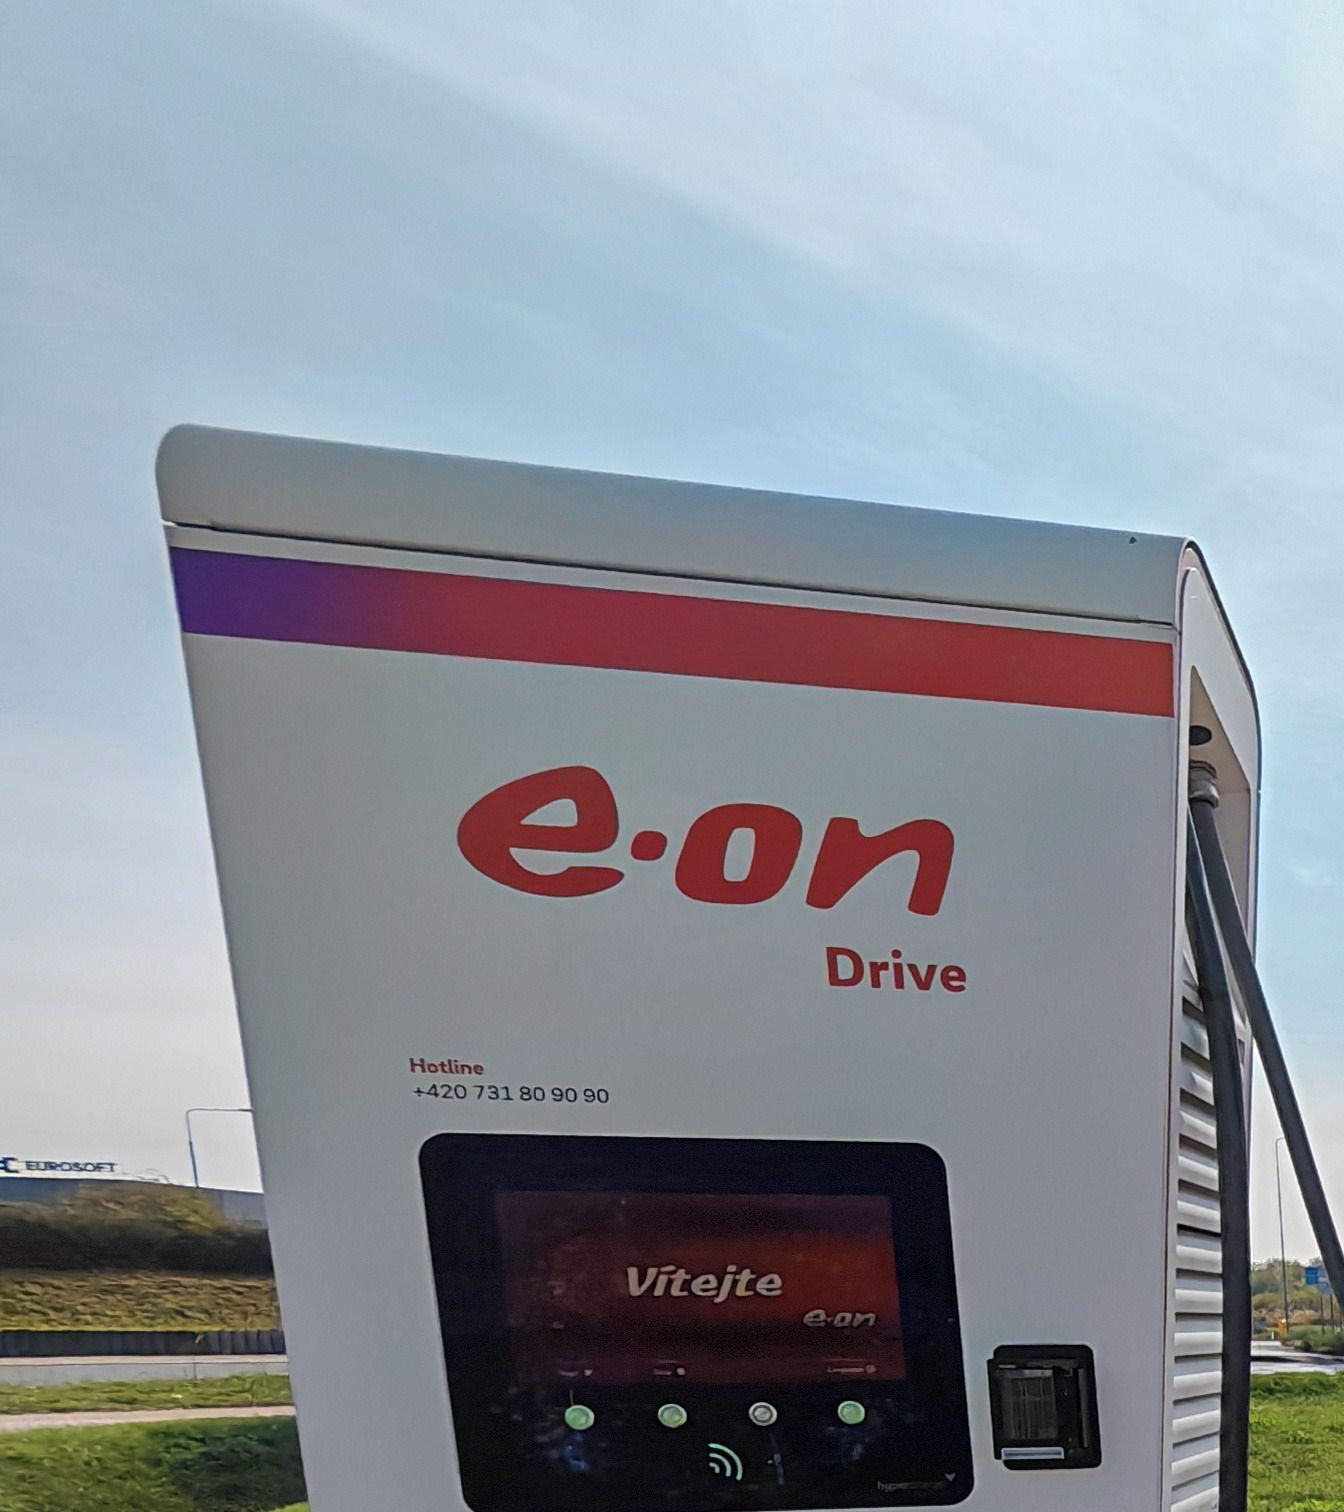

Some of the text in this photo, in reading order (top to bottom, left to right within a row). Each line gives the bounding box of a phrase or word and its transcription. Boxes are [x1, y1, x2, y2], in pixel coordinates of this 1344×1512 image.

[825, 946, 967, 992] Drive
[409, 1057, 484, 1076] Hotline
[413, 1083, 609, 1104] +420 731 80 90 90
[25, 1161, 118, 1172] EUROSOFT
[627, 1265, 783, 1304] Vítejte
